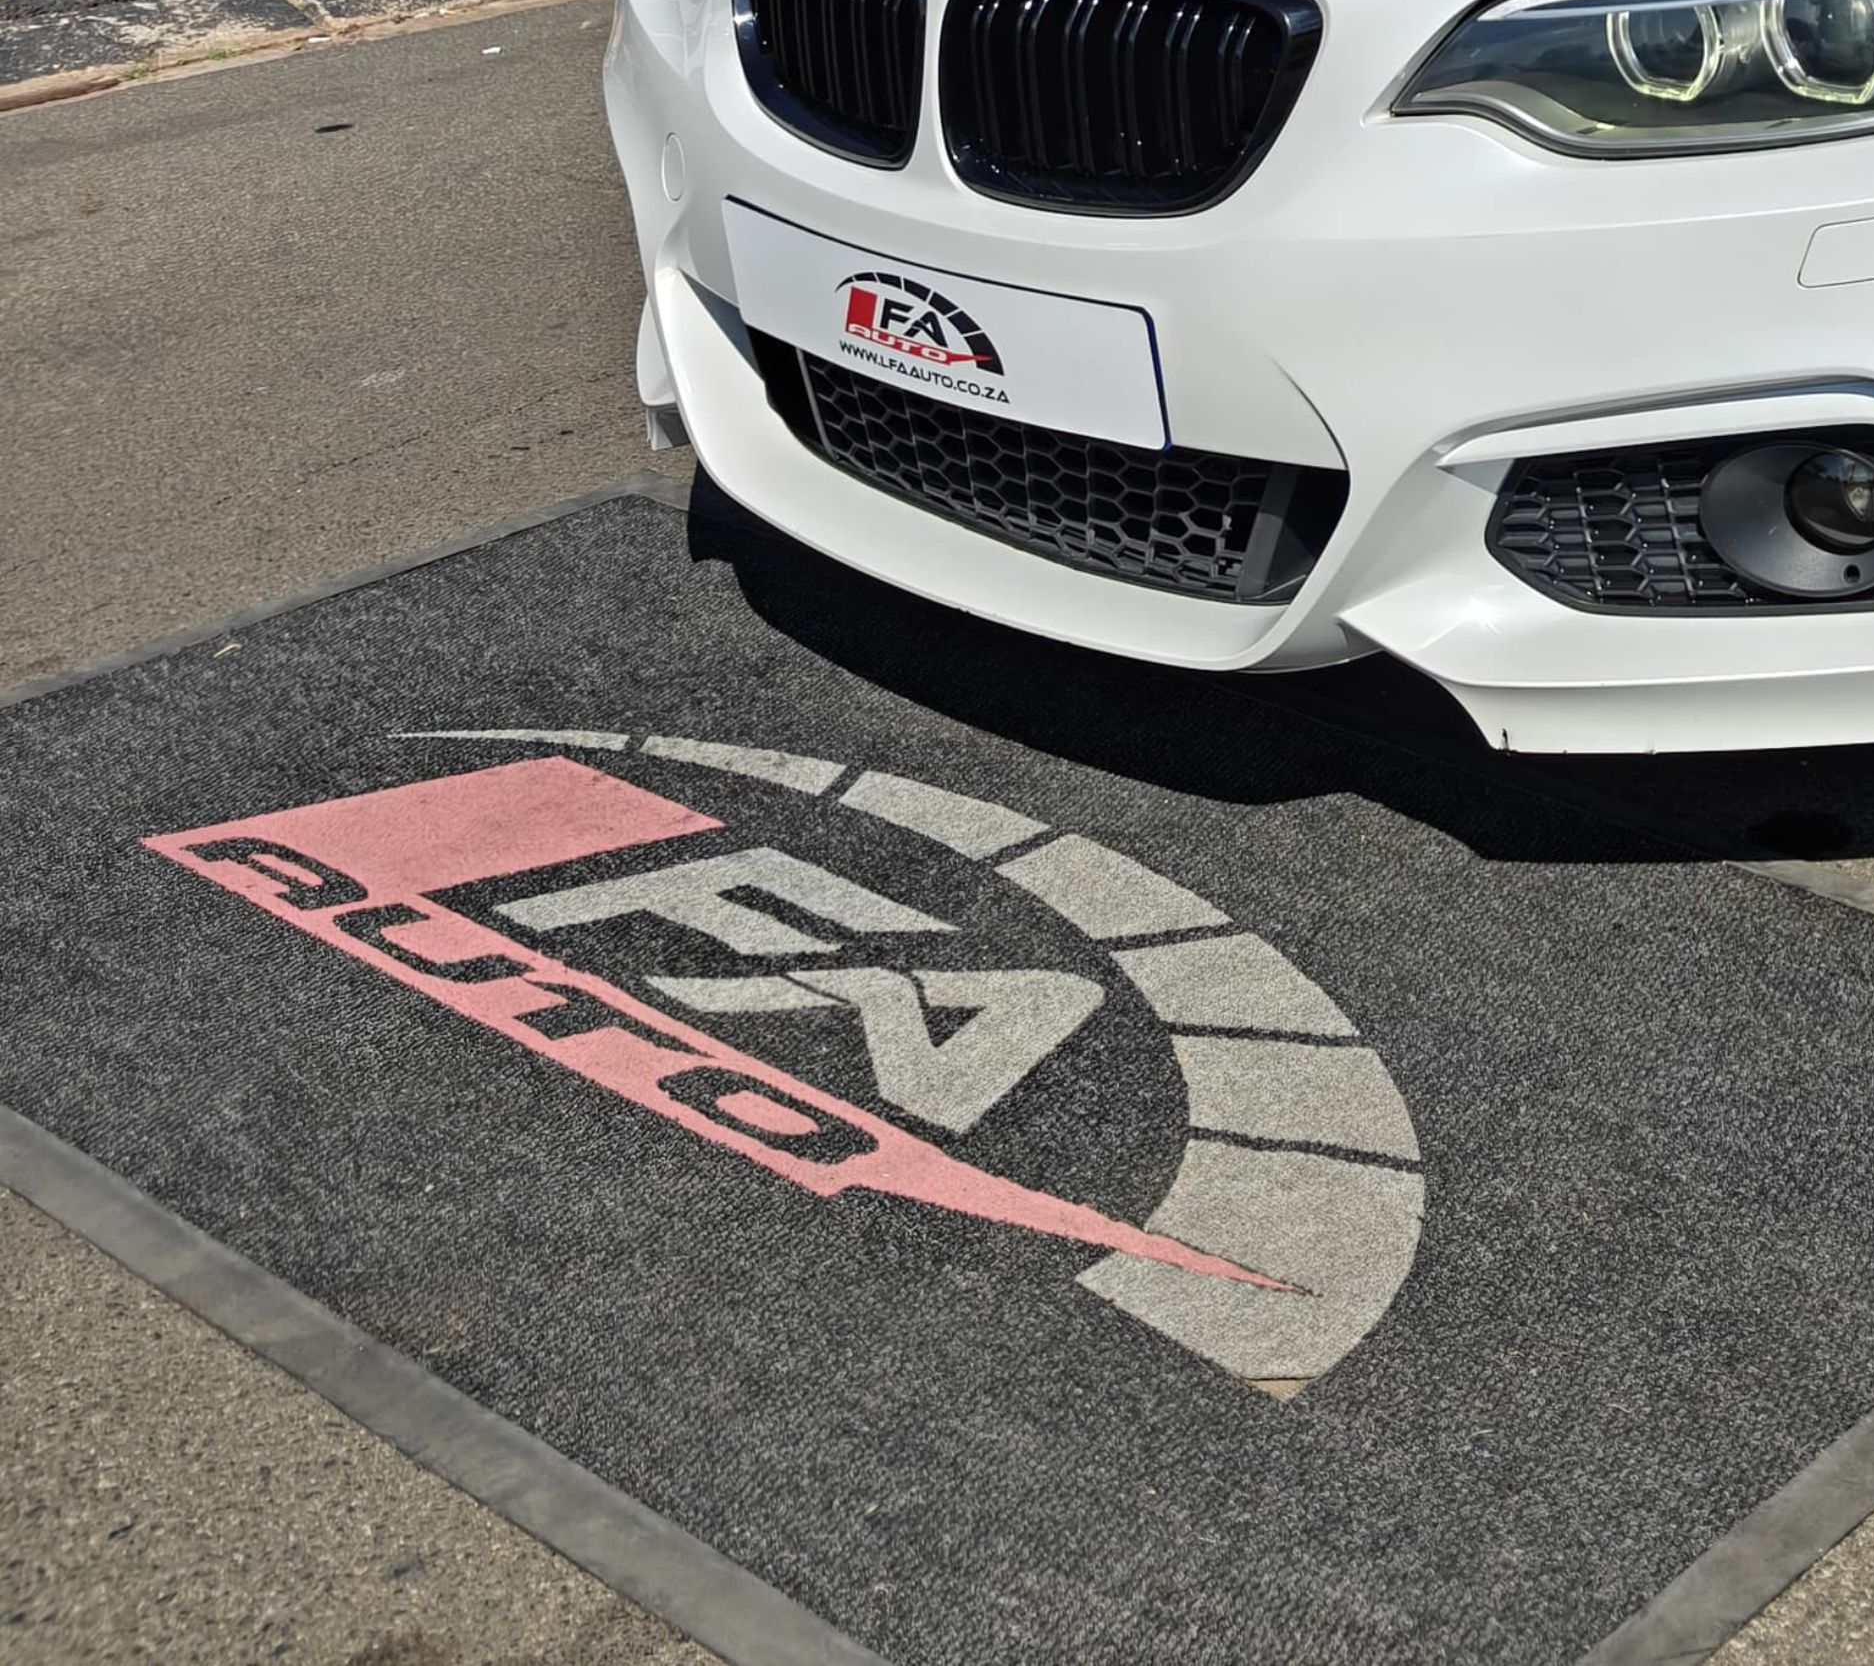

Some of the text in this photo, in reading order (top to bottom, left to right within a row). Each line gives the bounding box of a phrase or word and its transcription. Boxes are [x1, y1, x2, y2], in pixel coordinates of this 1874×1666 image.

[839, 339, 1010, 404] WWW.LFAAUTO.CO.ZA
[848, 323, 948, 363] AUTO
[184, 835, 880, 1165] AUTO
